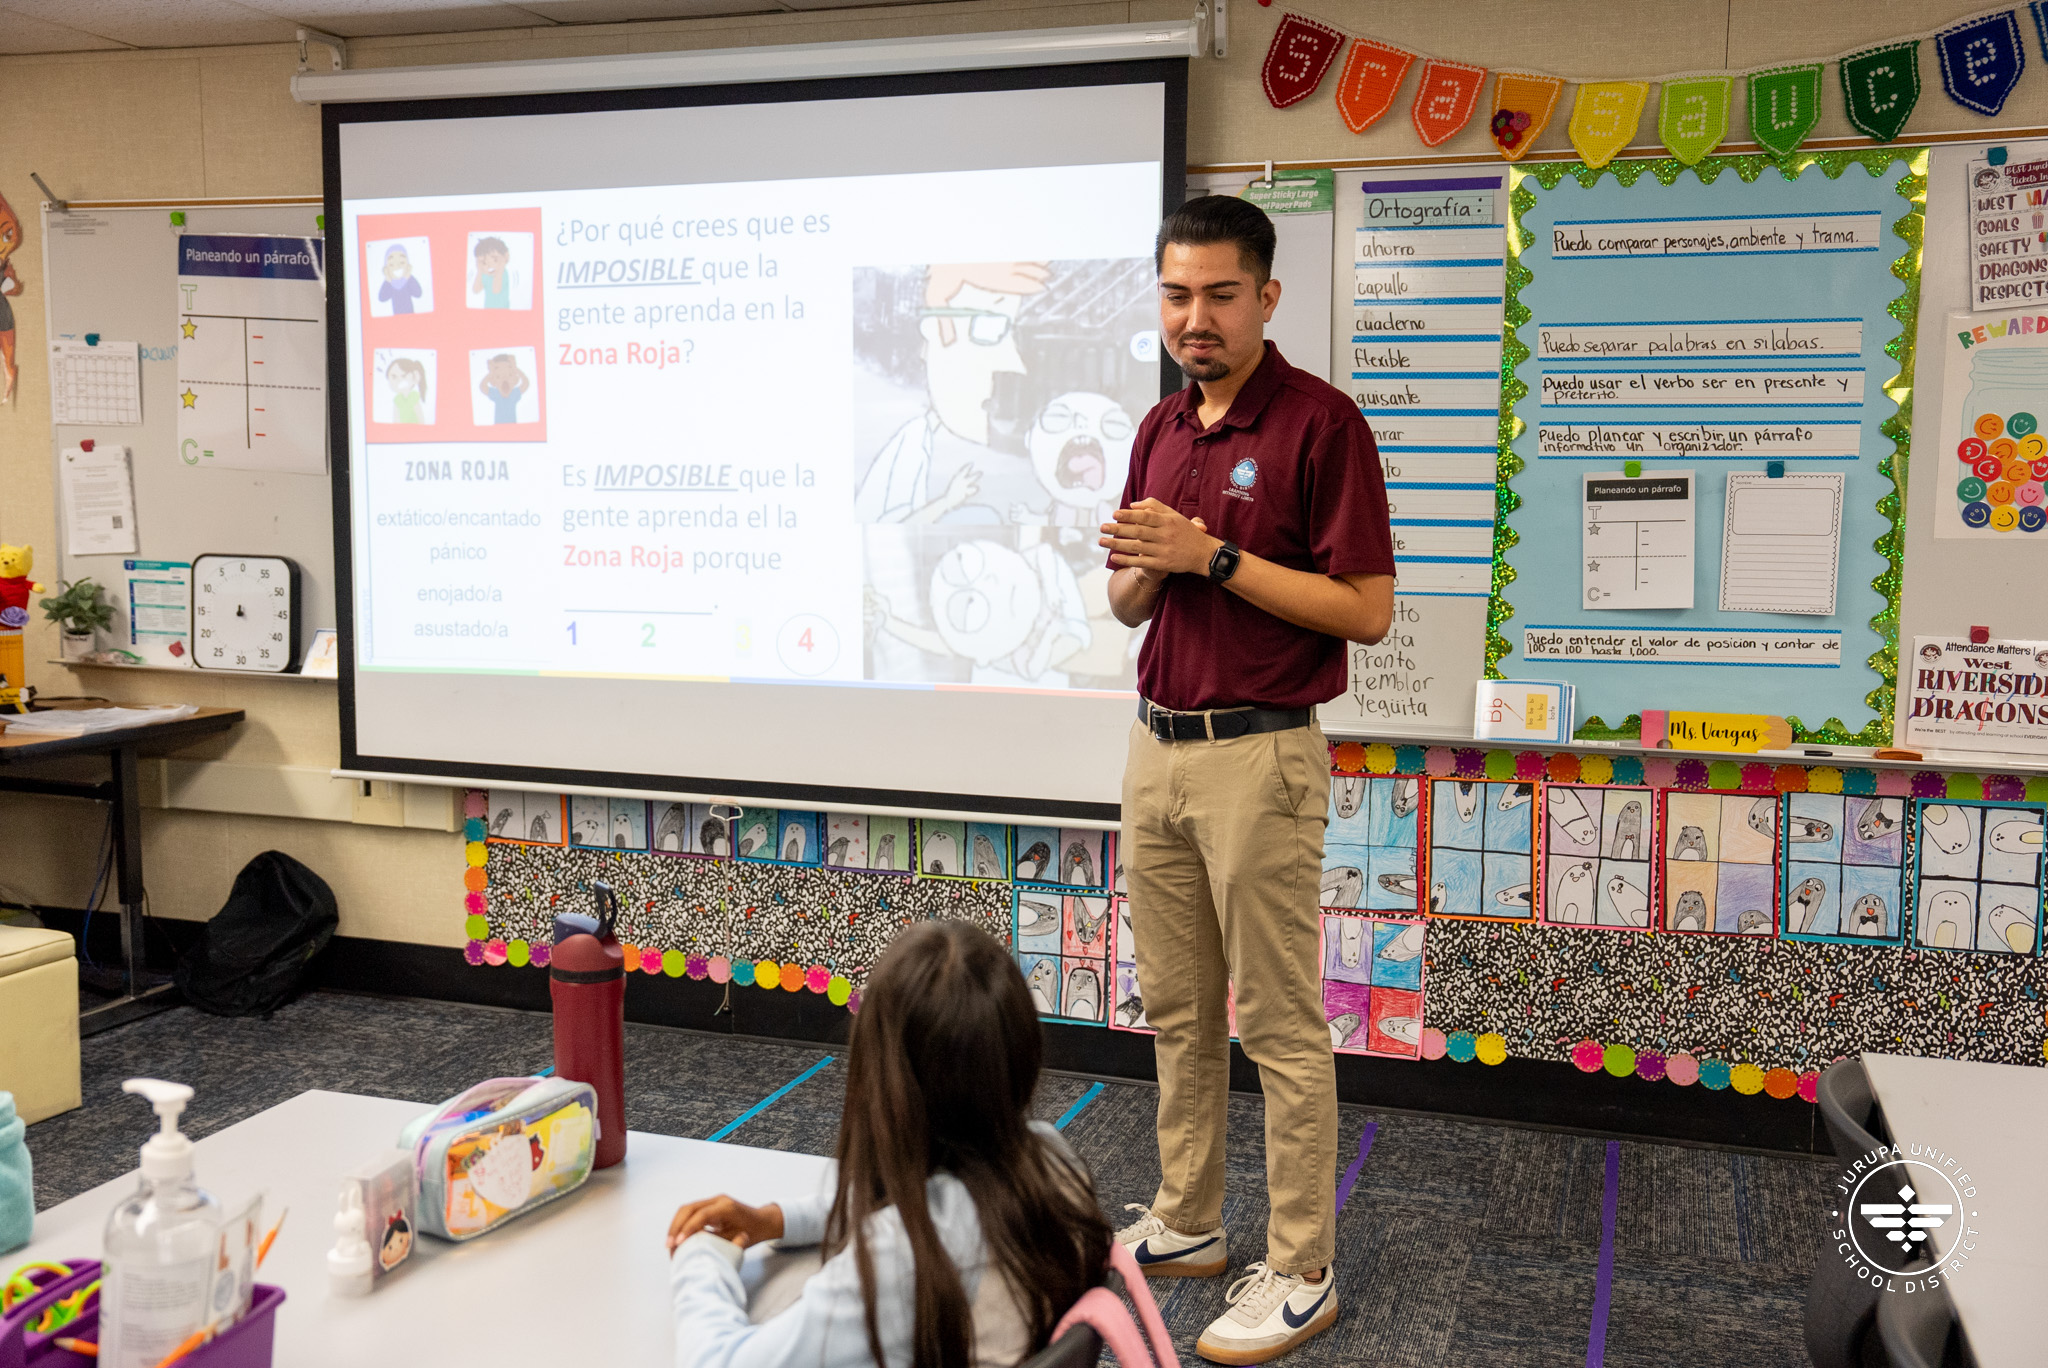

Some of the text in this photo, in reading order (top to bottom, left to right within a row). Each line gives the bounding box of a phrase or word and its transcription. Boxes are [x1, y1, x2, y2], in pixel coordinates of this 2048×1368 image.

[1250, 190, 1318, 201] Super Sticky Large
[1270, 200, 1312, 210] Paper Pads
[1977, 193, 2017, 212] WEST
[556, 211, 831, 246] ¿Por qué crees que es
[1977, 217, 2020, 236] GOALS
[1553, 230, 1592, 252] Puedo
[1599, 238, 1659, 254] comparar
[1796, 234, 1804, 250] y
[1812, 222, 1859, 244] trama.
[1979, 237, 2031, 258] SAFETY
[186, 248, 310, 266] Planeando un párrafo
[557, 253, 778, 287] IMPOSIBLE que la
[1979, 258, 2048, 281] DRAGONS
[1358, 271, 1408, 300] capullo
[558, 294, 805, 331] gente aprenda en la
[1356, 311, 1426, 332] cuaderno
[1542, 331, 1580, 354] Puedo
[1584, 341, 1638, 355] separar
[1648, 332, 1717, 355] palabras
[1725, 339, 1746, 350] en
[559, 339, 696, 370] Zona Roja?
[1354, 347, 1411, 369] flexible
[1590, 379, 1622, 390] usar
[1629, 374, 1647, 390] el
[1654, 374, 1695, 391] verbo
[1702, 378, 1728, 389] ser
[1735, 377, 1756, 389] en
[1764, 374, 1826, 394] presente
[1836, 378, 1848, 392] y
[1356, 384, 1421, 409] guisante
[1729, 431, 1748, 442] un
[1754, 426, 1813, 446] párrafo
[404, 459, 510, 482] ZONA ROJA
[562, 462, 816, 494] Es IMPOSIBLE que la
[1594, 486, 1636, 494] Planeando
[1652, 484, 1682, 494] párrafo
[376, 508, 542, 528] extático/encantado
[562, 503, 798, 533] gente aprenda el la
[429, 542, 488, 564] pánico
[563, 545, 782, 574] Zona Roja porque
[219, 568, 225, 577] 5
[240, 563, 246, 572] 0
[260, 569, 270, 578] 55
[203, 584, 212, 594] 10
[274, 587, 285, 597] 50
[416, 585, 503, 605] enojado/a
[197, 607, 206, 616] 15
[277, 610, 288, 620] 45
[200, 629, 212, 638] 20
[272, 632, 283, 642] 40
[413, 619, 509, 640] asustado/a
[566, 621, 578, 646] 1
[640, 623, 657, 649] 2
[797, 627, 815, 653] 4
[1527, 632, 1563, 646] Puedo
[1569, 635, 1626, 646] entender
[1631, 636, 1642, 647] el
[1649, 637, 1679, 647] valor
[1684, 638, 1701, 648] de
[1761, 642, 1768, 651] y
[1774, 638, 1816, 650] contar
[1822, 639, 1840, 650] de
[1528, 643, 1546, 654] 100
[1566, 646, 1582, 654] 100
[1945, 642, 1995, 654] Attendance
[213, 648, 224, 656] 25
[236, 655, 247, 664] 30
[260, 649, 270, 659] 35
[1353, 649, 1416, 671] Pronto
[1963, 658, 2012, 670] West
[1351, 671, 1434, 694] temblor
[1483, 698, 1503, 722] Bb
[1913, 697, 2048, 726] DRAGONS
[1670, 720, 1760, 746] Ms. Vargas
